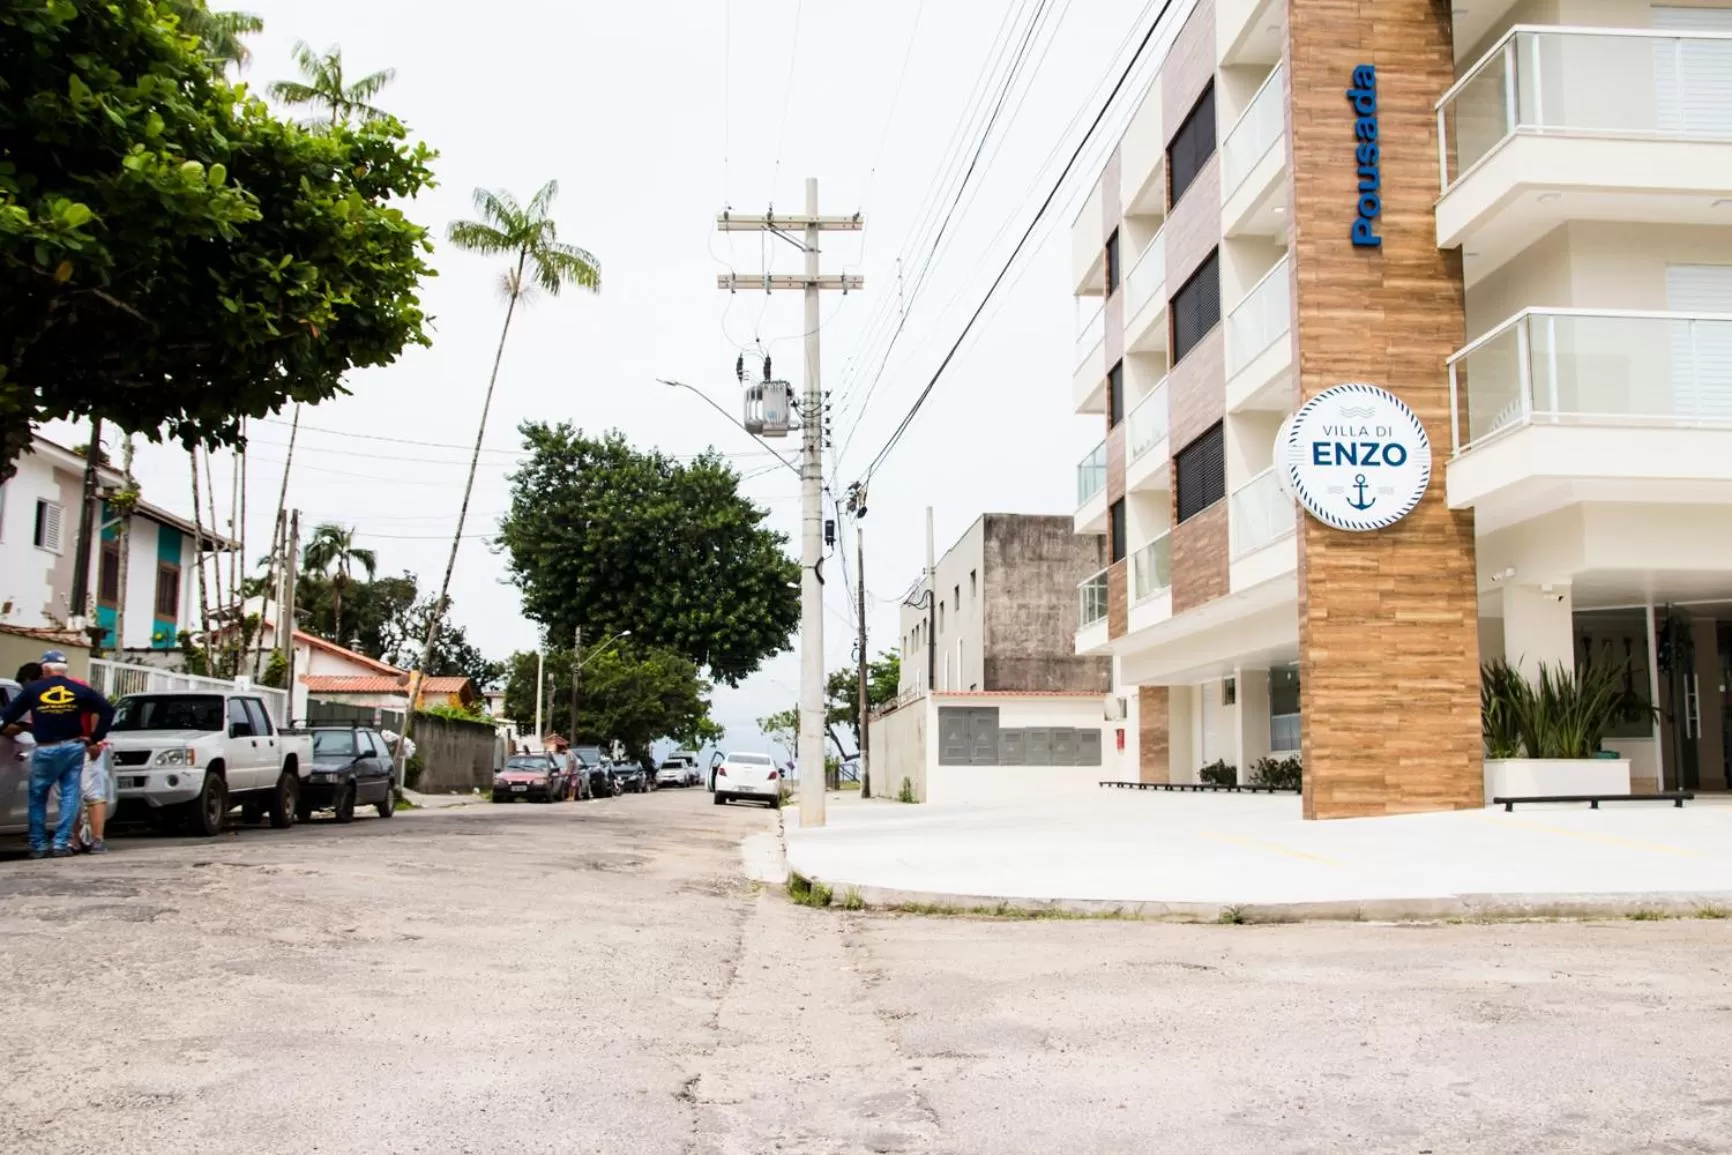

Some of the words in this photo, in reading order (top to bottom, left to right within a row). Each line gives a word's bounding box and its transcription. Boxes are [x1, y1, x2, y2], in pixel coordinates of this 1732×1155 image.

[1346, 64, 1382, 247] Pousada
[1322, 425, 1369, 437] VILLA
[1376, 426, 1392, 437] DI
[1312, 441, 1407, 467] ENZO
